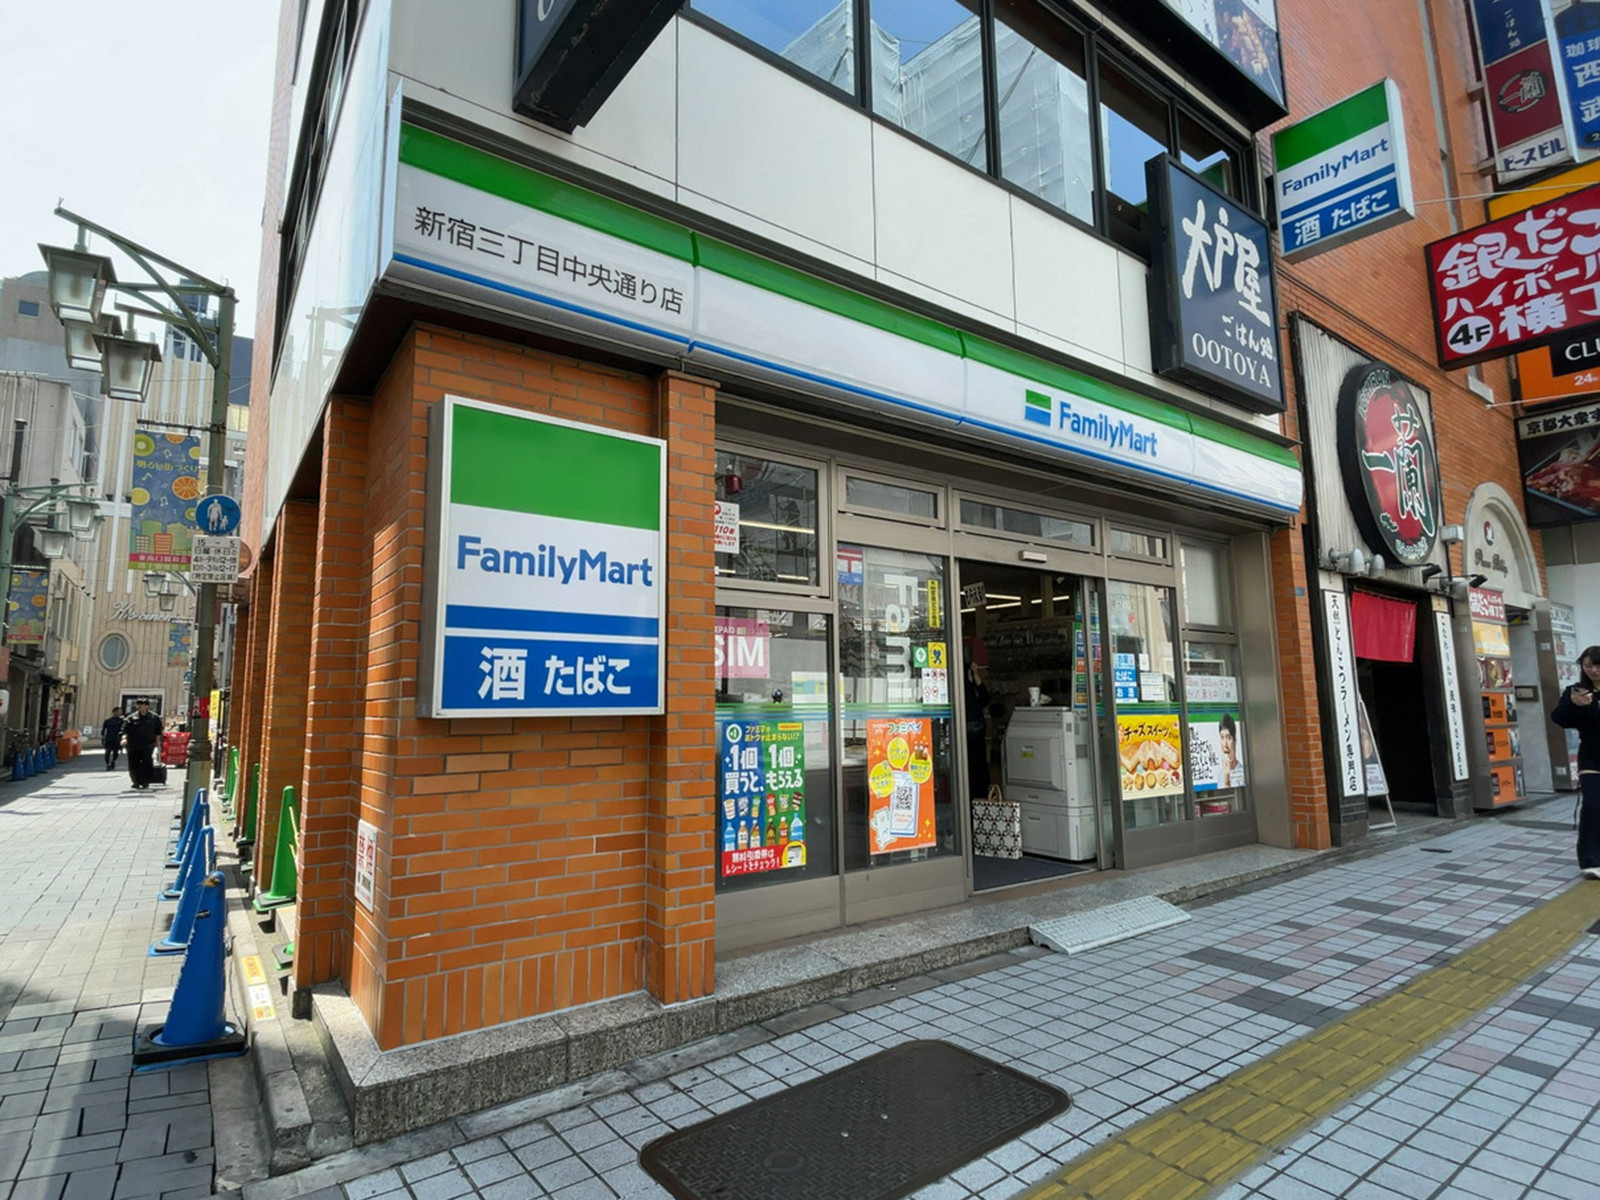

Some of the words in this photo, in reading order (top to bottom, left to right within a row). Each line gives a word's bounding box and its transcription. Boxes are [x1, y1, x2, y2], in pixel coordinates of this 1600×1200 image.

[1282, 138, 1389, 196] FamilyMart
[1502, 137, 1565, 172] ピースビル
[1294, 213, 1321, 246] 酒
[1331, 189, 1390, 230] たばこ
[414, 206, 684, 315] 新宿三丁目中央通り店
[1181, 199, 1271, 327] 大戸屋
[1192, 332, 1272, 388] OOTOYA
[1449, 322, 1491, 346] 4F
[1059, 400, 1158, 457] FamilyMart
[1362, 403, 1436, 538] 一蘭
[456, 534, 653, 587] FamilyMart
[477, 646, 528, 701] 酒
[543, 655, 631, 696] たばこ
[730, 744, 759, 771] 1個
[766, 768, 803, 791] もらえる
[769, 743, 795, 769] 1個
